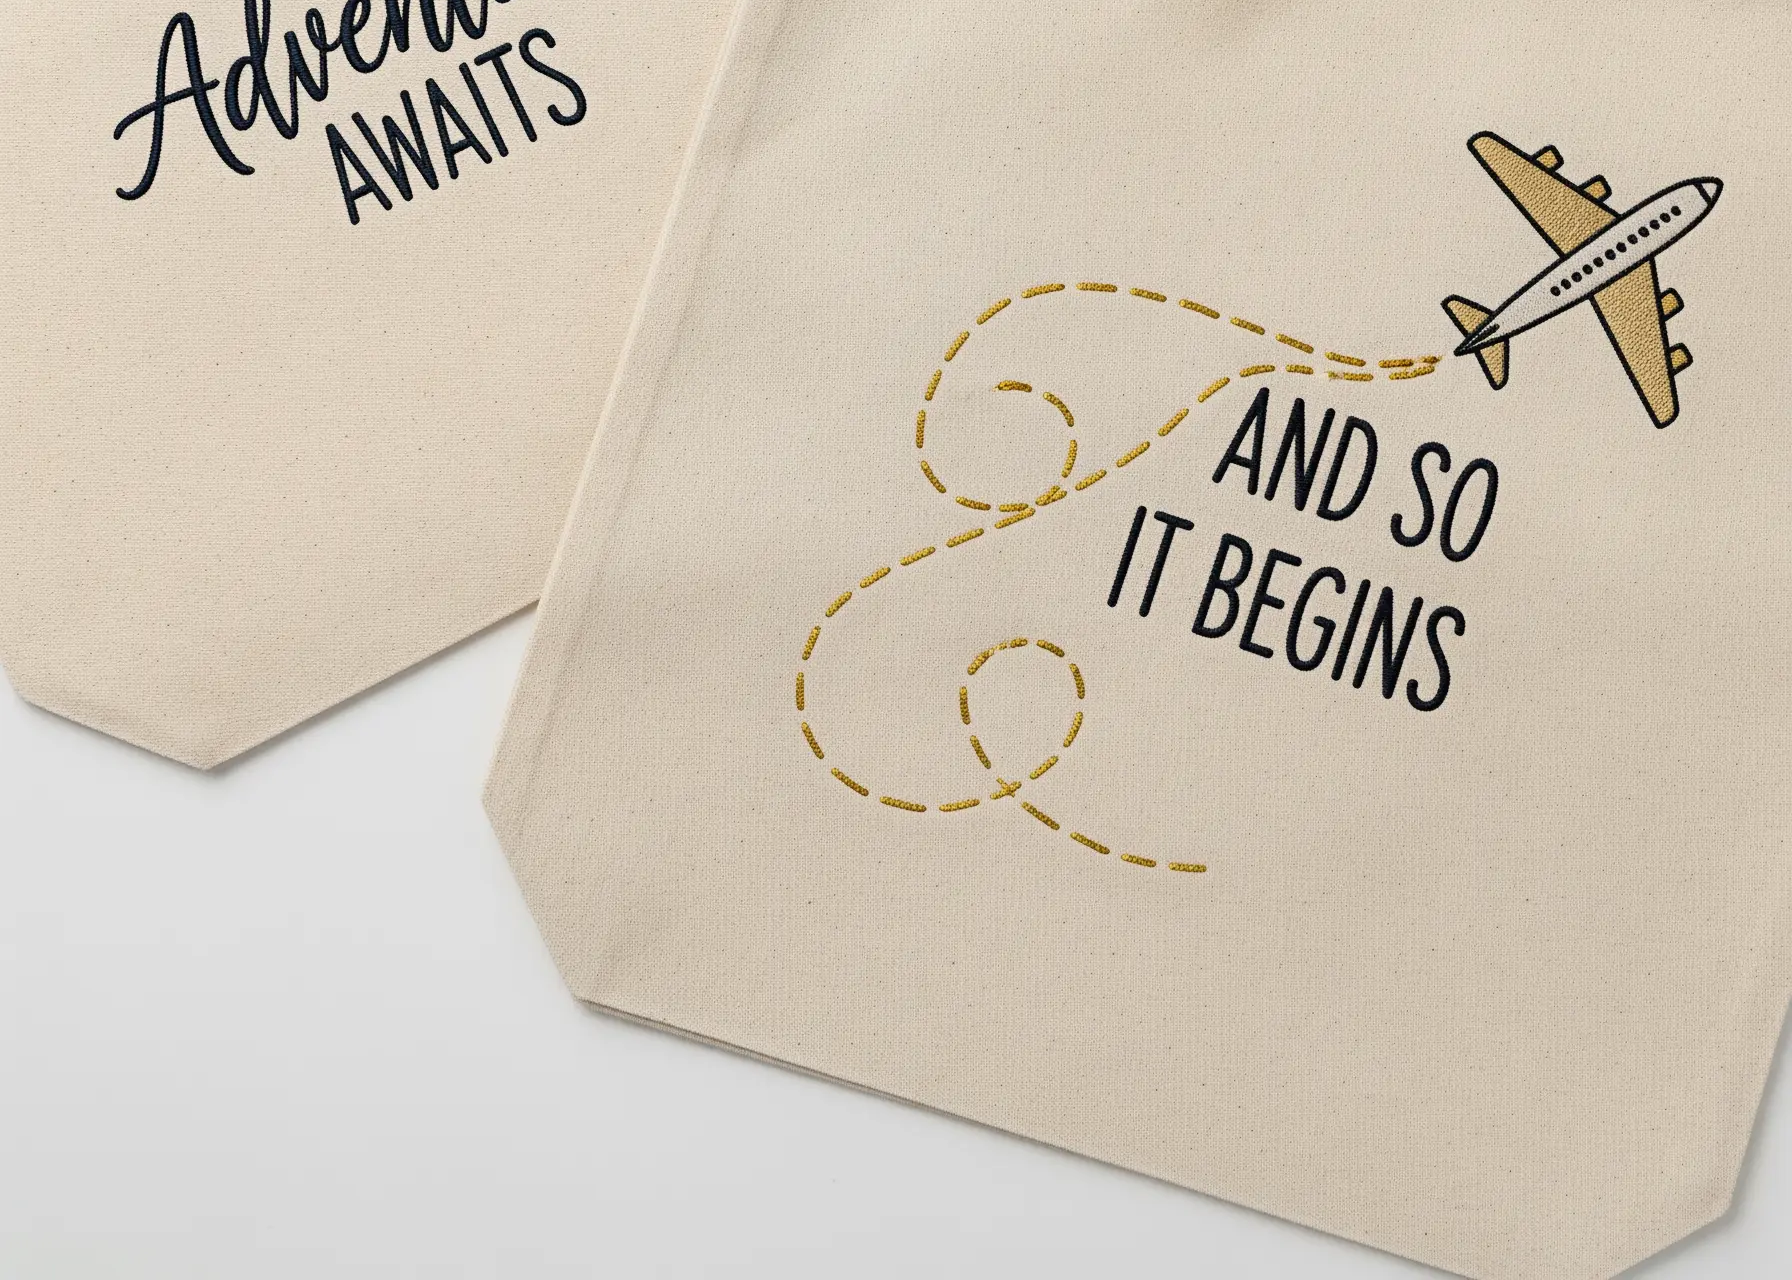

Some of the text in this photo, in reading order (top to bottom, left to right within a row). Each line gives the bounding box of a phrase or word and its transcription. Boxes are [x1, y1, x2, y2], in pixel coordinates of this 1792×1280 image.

[324, 27, 588, 226] AWAITS
[1211, 386, 1499, 563] AND SO
[1106, 505, 1466, 713] IT BEGINS
